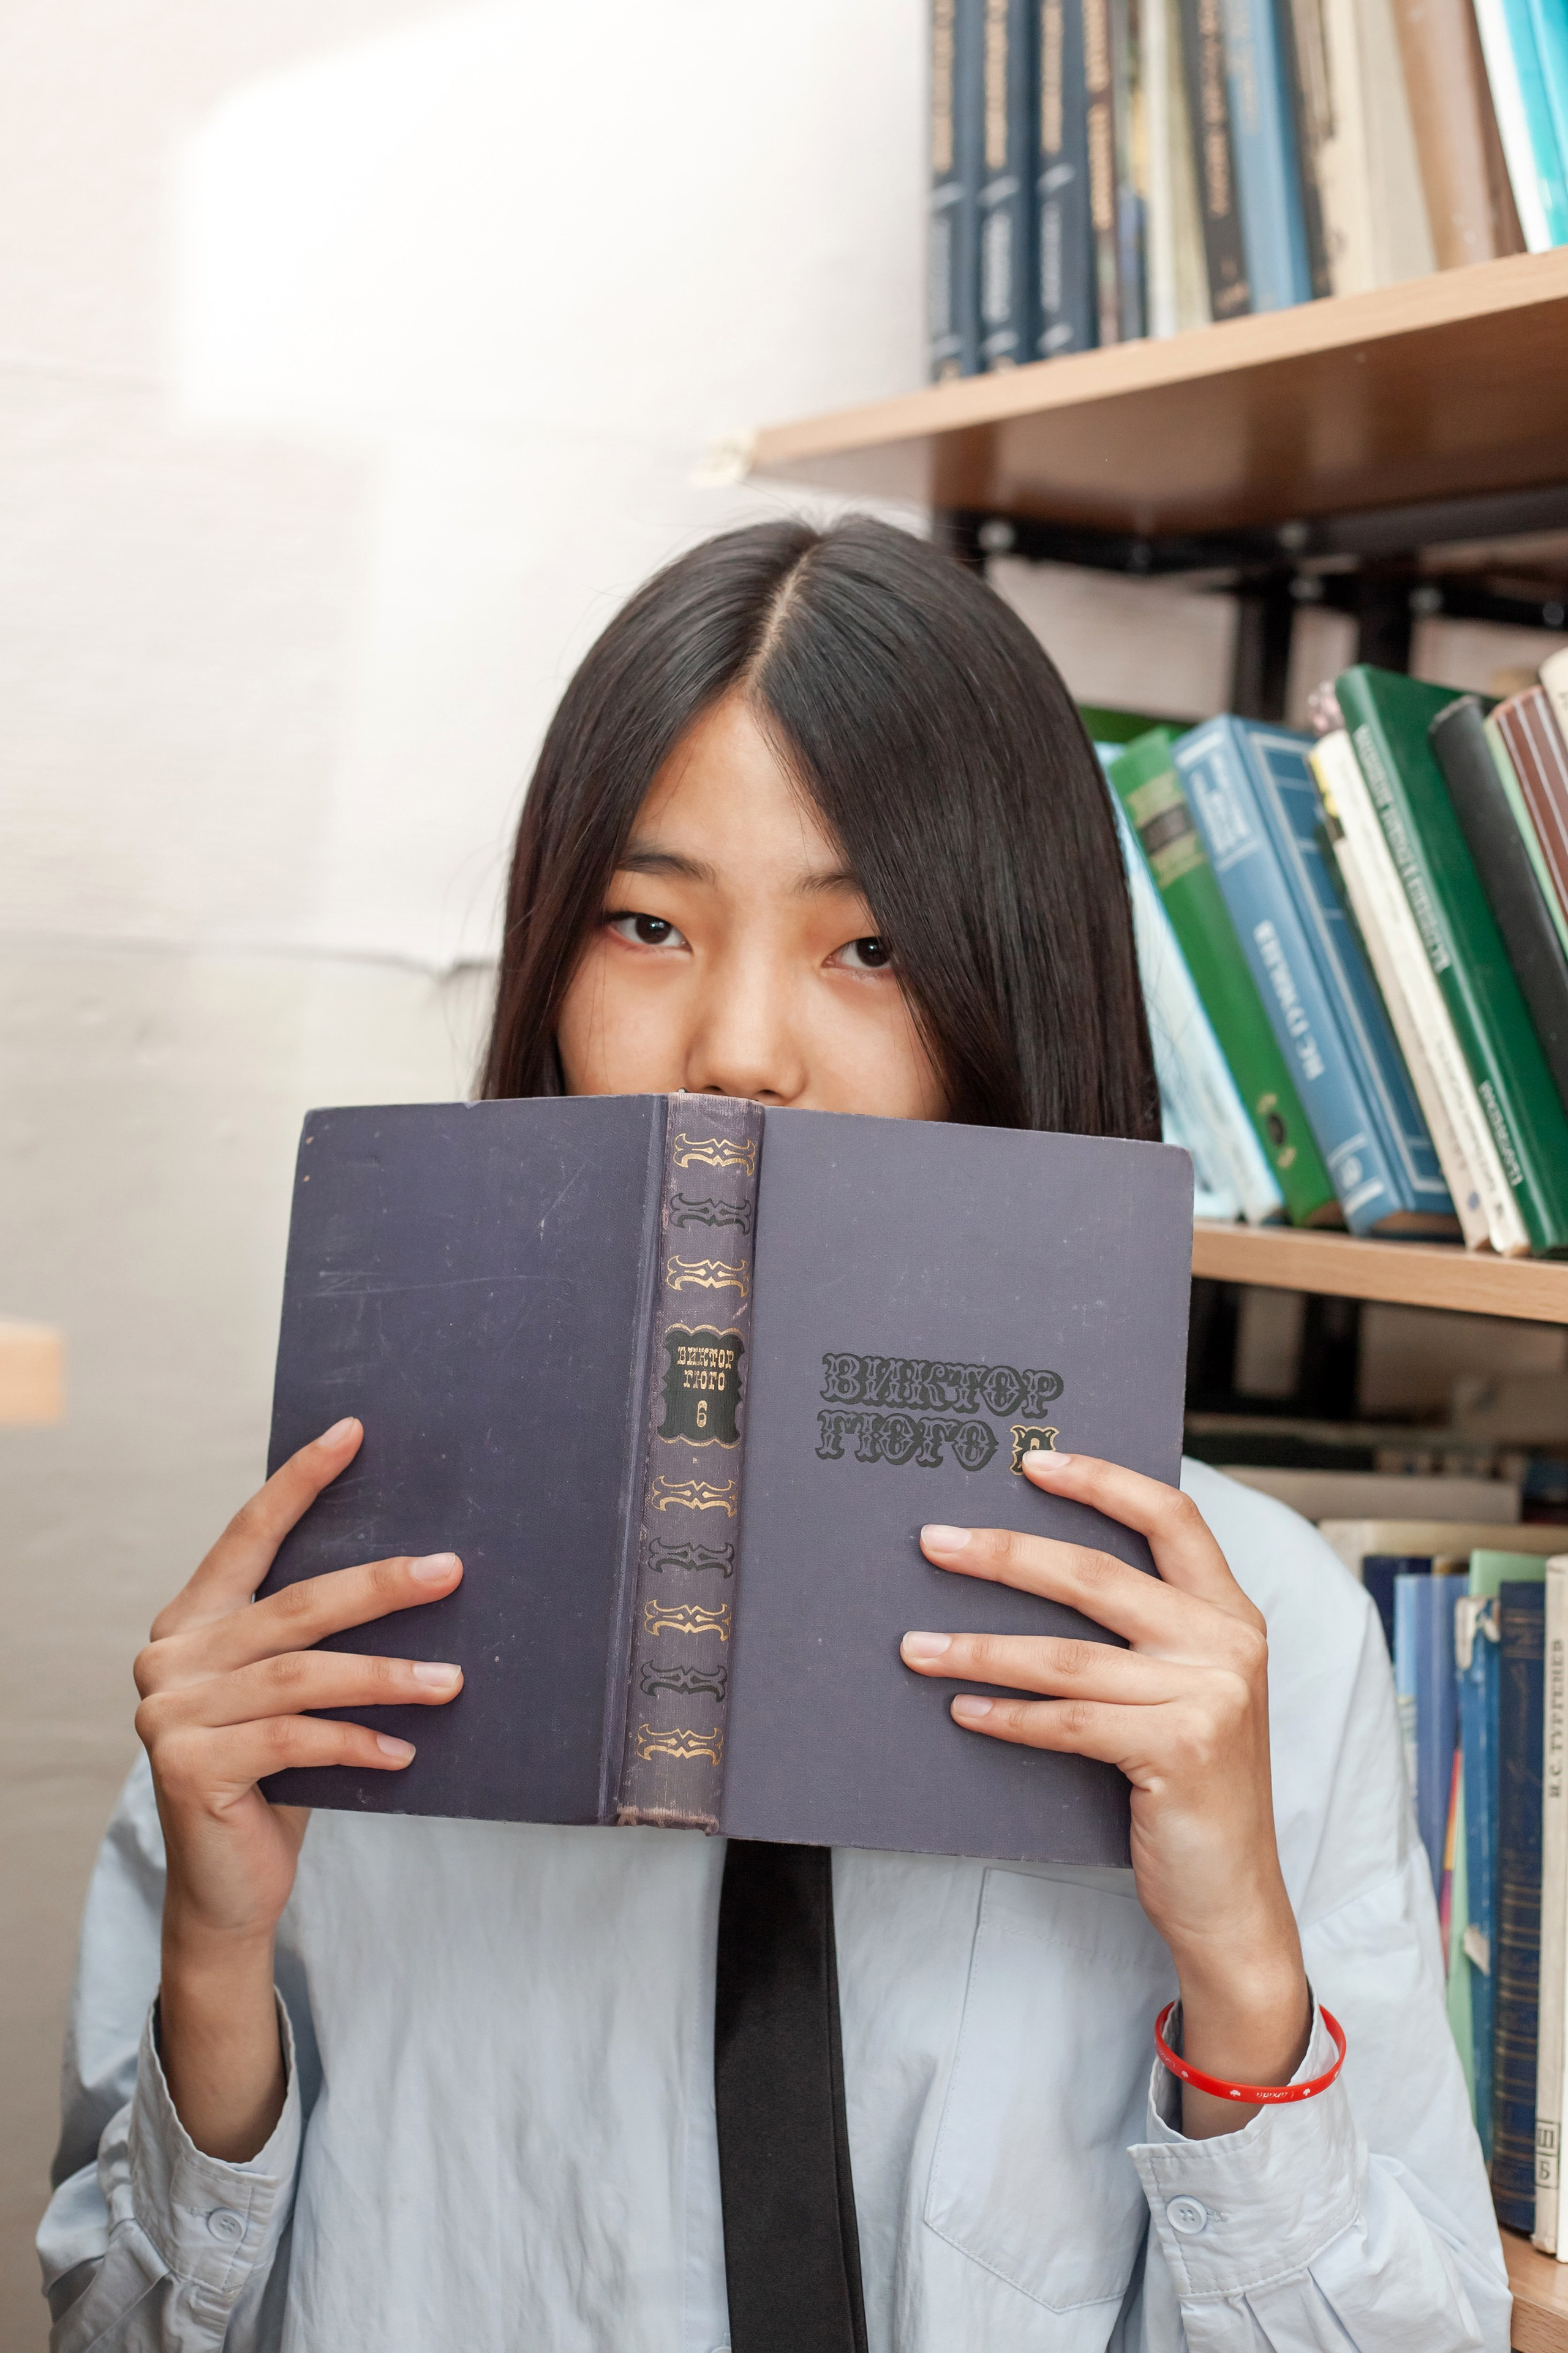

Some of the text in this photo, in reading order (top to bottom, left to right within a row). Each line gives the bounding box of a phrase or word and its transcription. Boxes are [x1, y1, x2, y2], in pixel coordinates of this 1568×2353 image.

[677, 1346, 734, 1369] ВИКТОР
[683, 1369, 725, 1391] ГЮГО
[820, 1353, 1064, 1419] ВИКТОР
[696, 1400, 708, 1427] 6
[815, 1410, 999, 1471] ГЮГО
